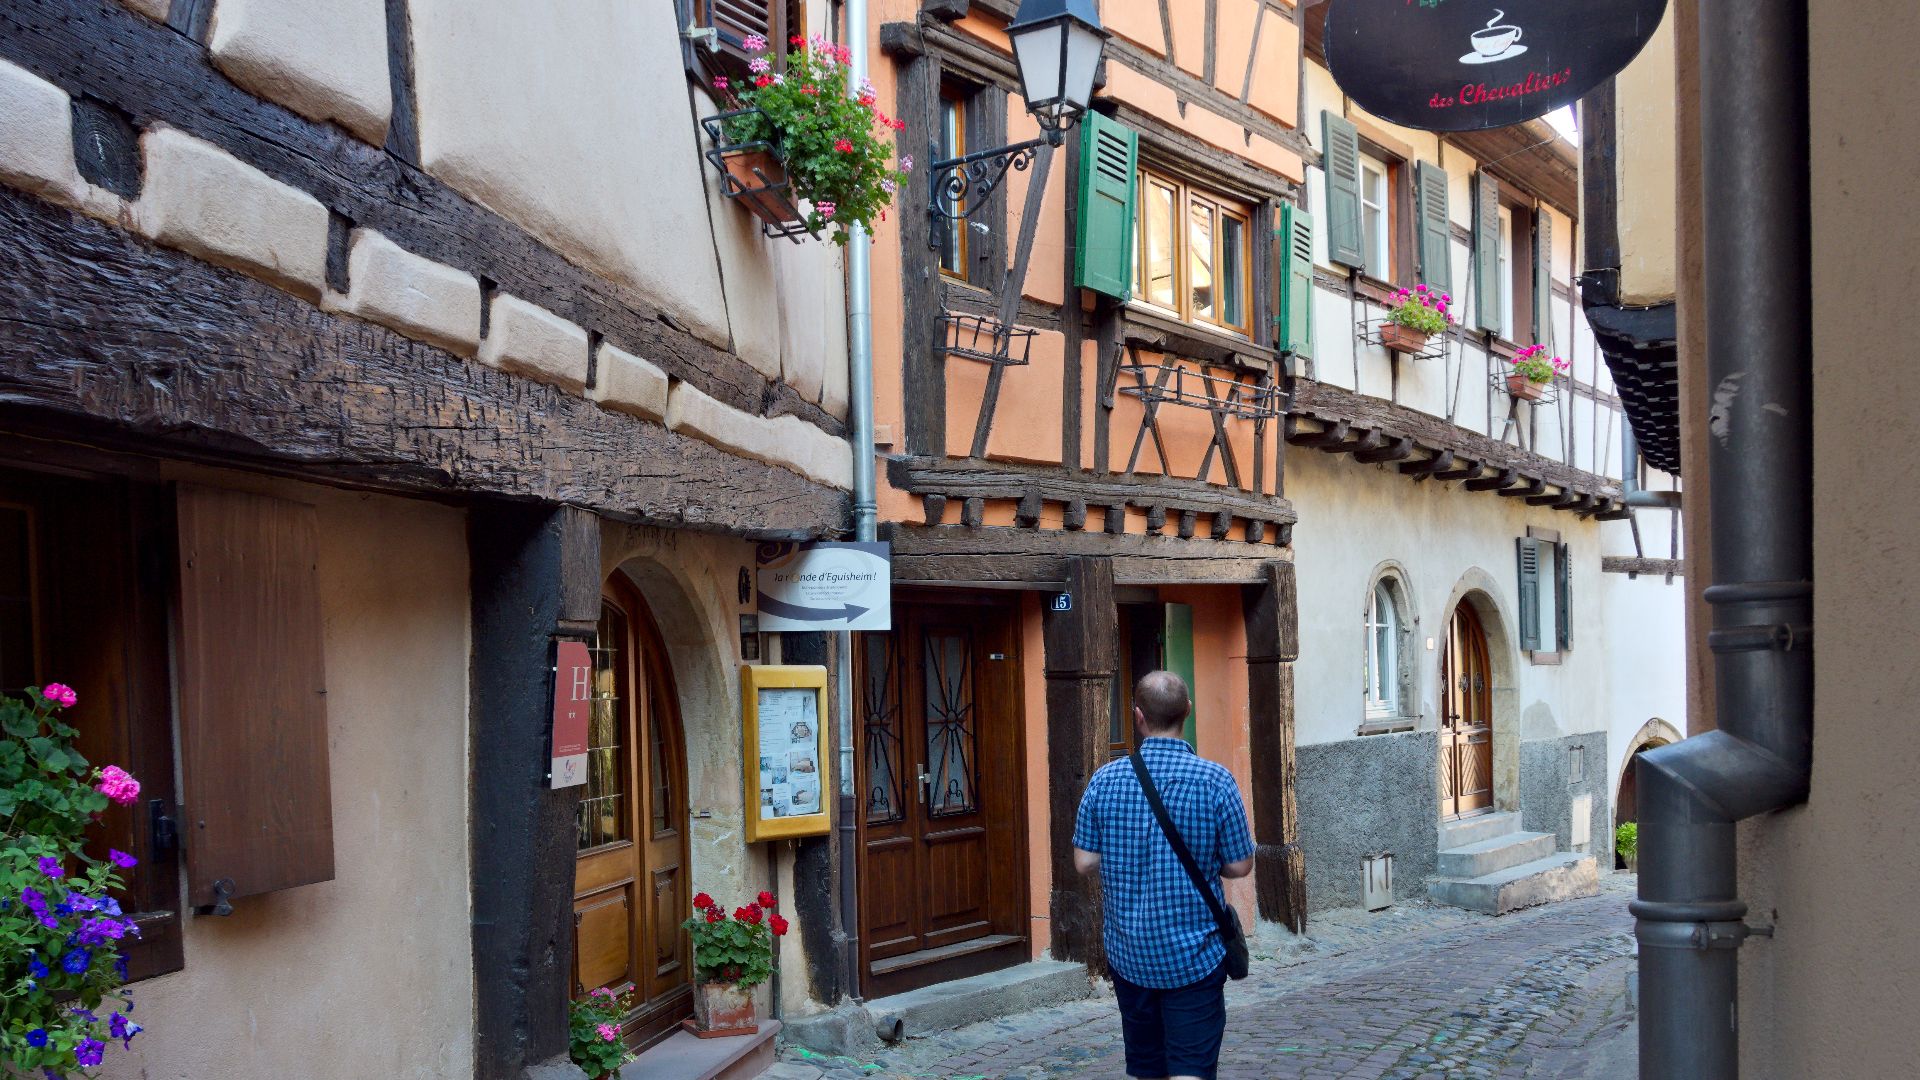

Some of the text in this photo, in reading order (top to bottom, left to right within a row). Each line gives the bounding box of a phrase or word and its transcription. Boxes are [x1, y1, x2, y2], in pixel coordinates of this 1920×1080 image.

[1429, 67, 1571, 108] des Chevaliers
[775, 573, 784, 582] la
[1055, 596, 1067, 608] 15
[571, 666, 591, 701] H
